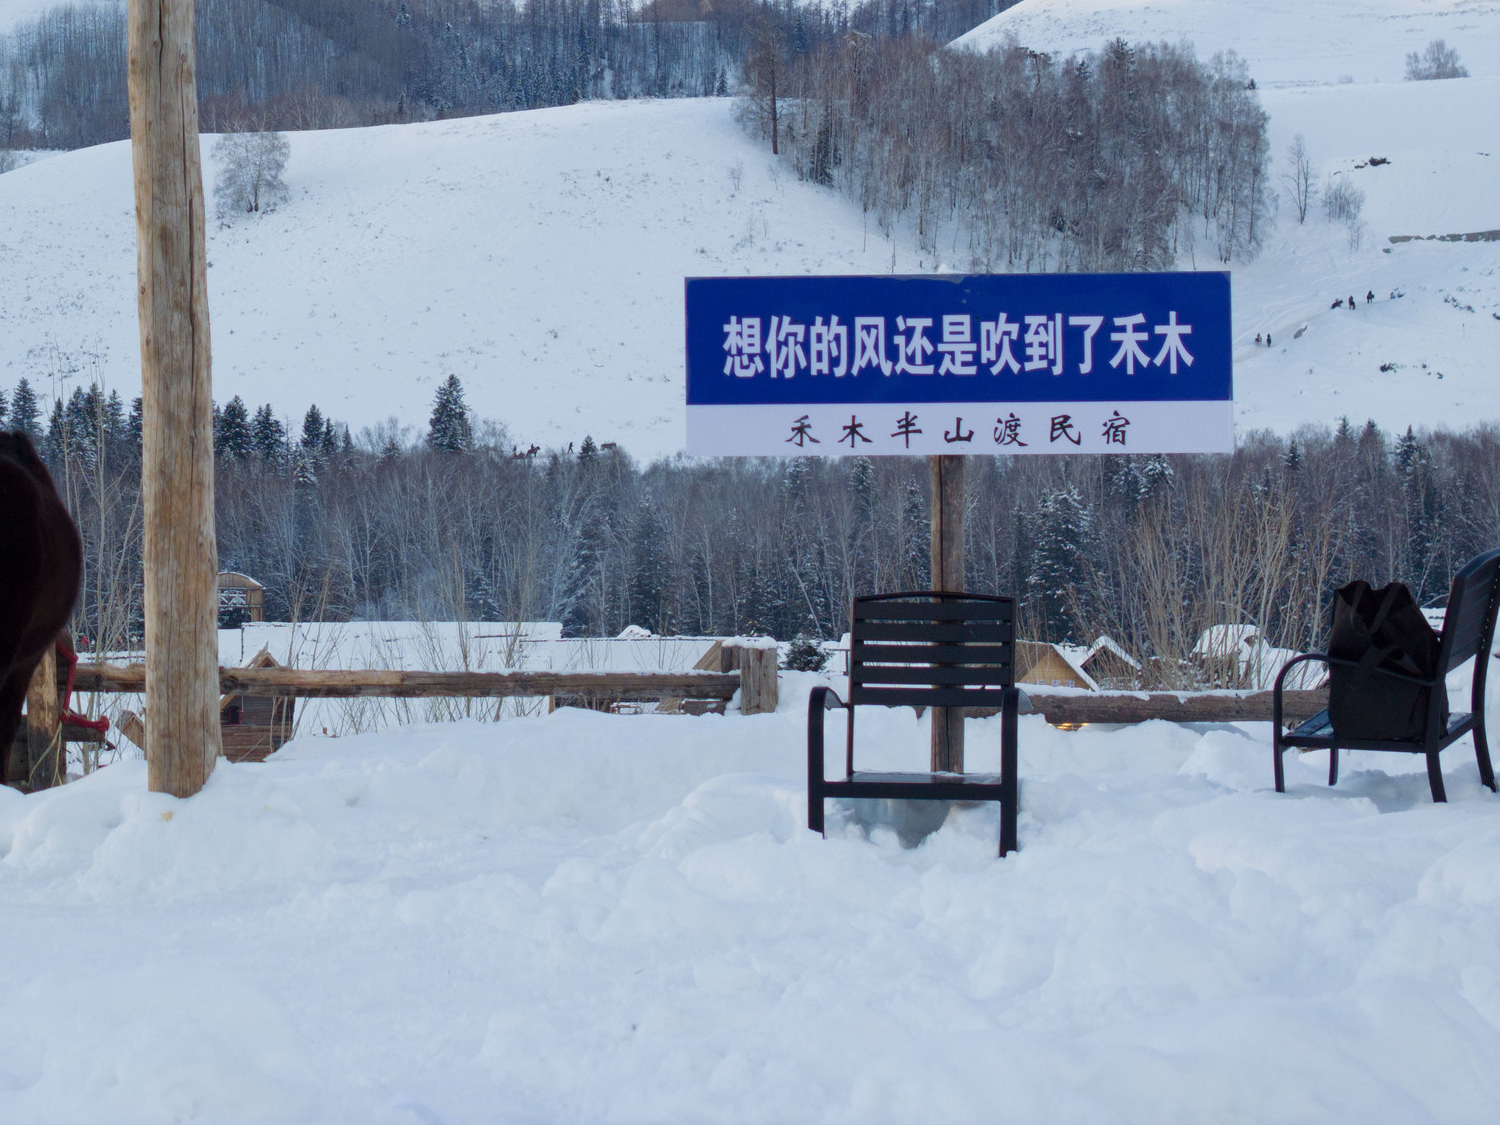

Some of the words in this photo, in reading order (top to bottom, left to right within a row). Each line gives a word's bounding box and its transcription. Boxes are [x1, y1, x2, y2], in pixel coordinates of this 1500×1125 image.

[722, 311, 1195, 378] 想你的风还是吹到了禾木
[784, 410, 1132, 447] 禾木半山渡民宿
